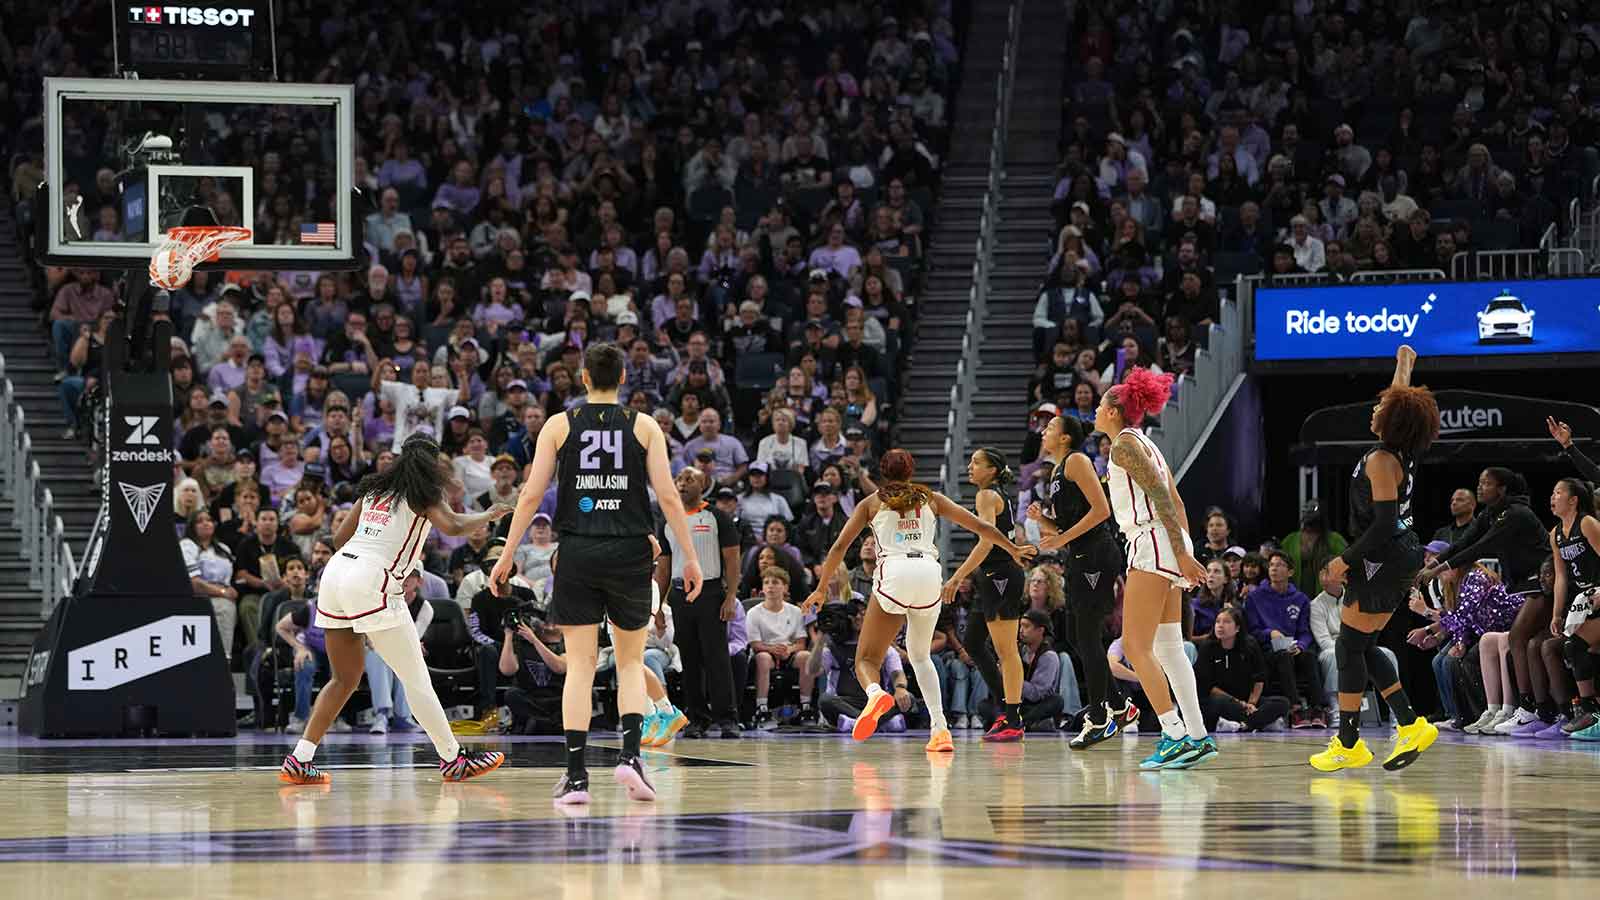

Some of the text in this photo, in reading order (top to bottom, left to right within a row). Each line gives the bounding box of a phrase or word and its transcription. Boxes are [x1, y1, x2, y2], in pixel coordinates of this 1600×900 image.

[163, 6, 255, 27] TISSOT
[1286, 306, 1420, 338] Ride today
[1440, 404, 1503, 428] kuten
[111, 448, 172, 463] zendesk
[580, 430, 623, 470] 24
[575, 474, 629, 491] ZANDALASINI
[594, 499, 622, 511] AT&T
[1571, 562, 1581, 577] 2
[81, 623, 196, 681] IREN
